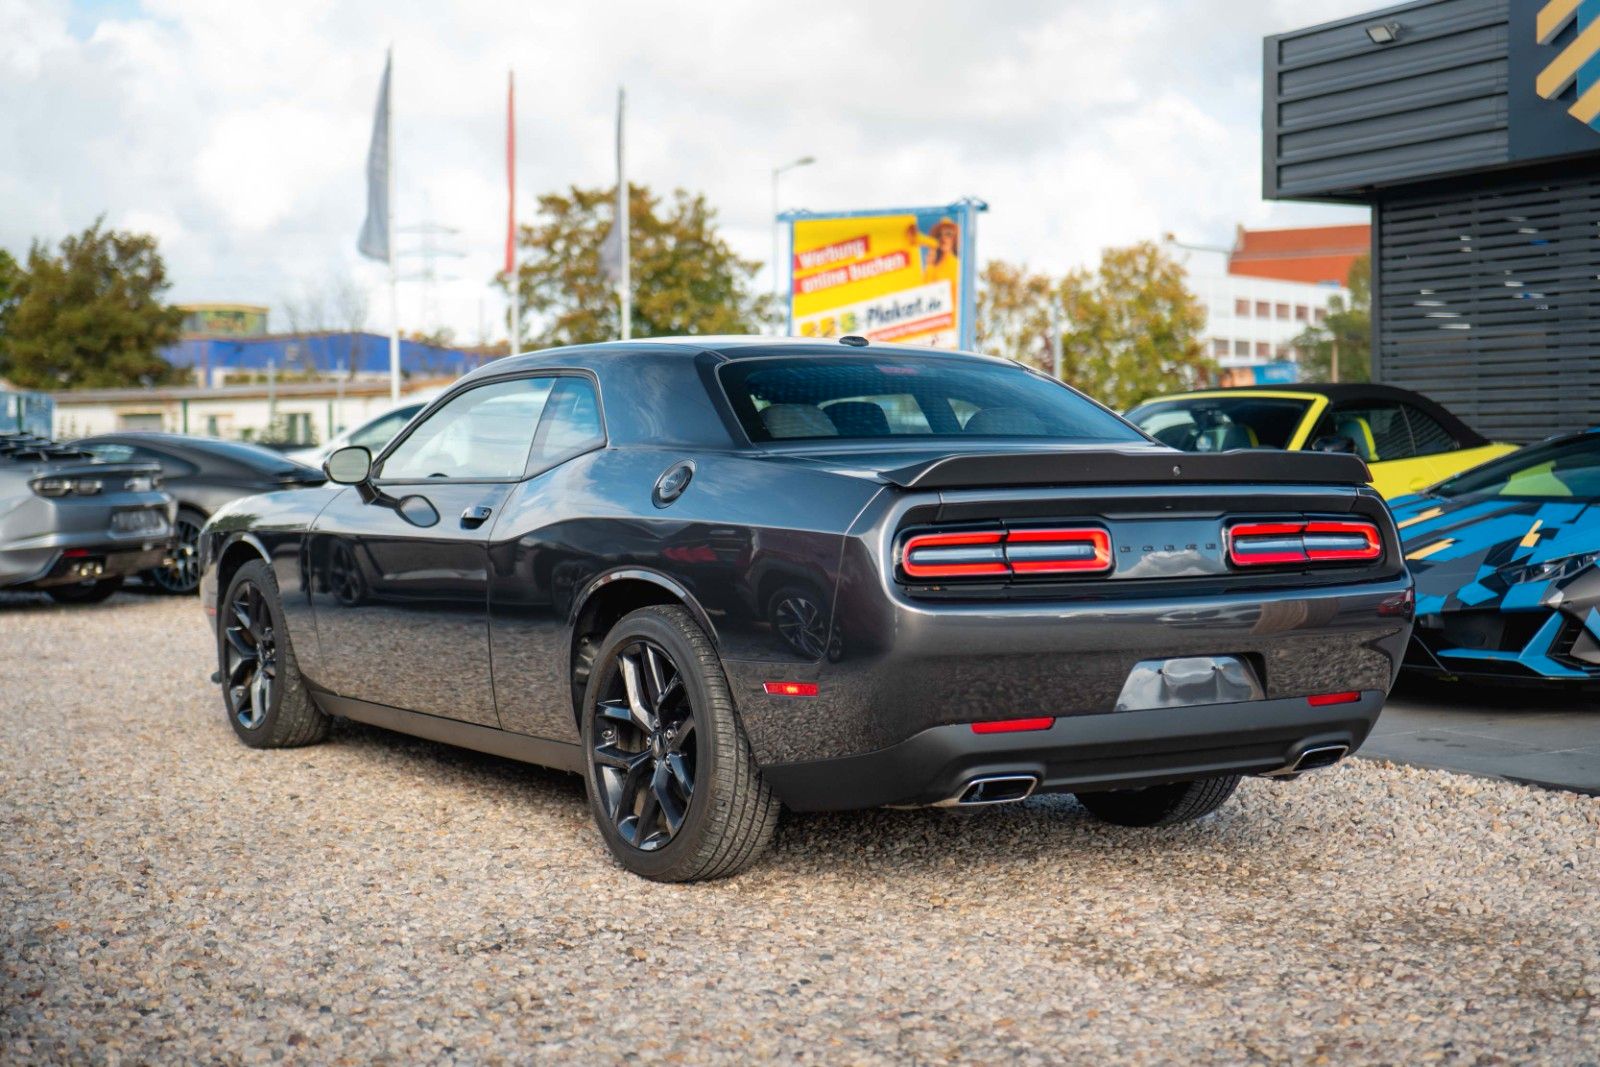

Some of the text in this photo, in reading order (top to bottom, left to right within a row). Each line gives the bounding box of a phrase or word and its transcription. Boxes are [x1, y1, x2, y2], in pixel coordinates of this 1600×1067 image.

[800, 239, 865, 268] Werbung
[801, 252, 906, 293] online buchen
[1119, 543, 1217, 553] DODGE
